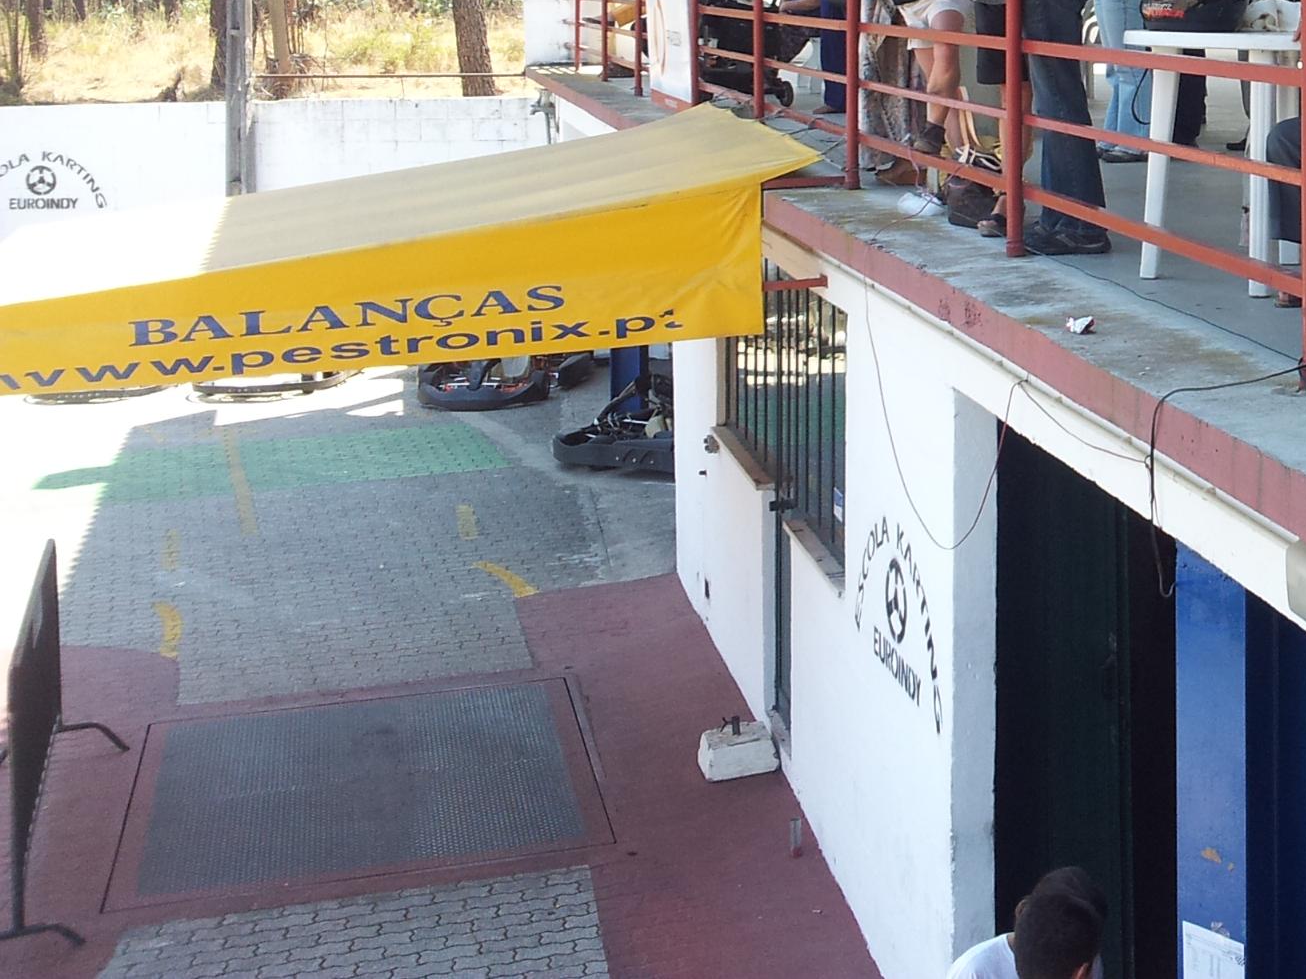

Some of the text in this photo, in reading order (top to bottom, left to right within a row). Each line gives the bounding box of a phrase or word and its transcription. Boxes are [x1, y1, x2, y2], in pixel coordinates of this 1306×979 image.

[9, 197, 79, 210] EUROINDY
[42, 151, 107, 209] KARTING
[128, 285, 565, 347] BALANÇAS
[854, 516, 943, 734] ESCOLA KARTING
[873, 625, 922, 707] EUROINDY
